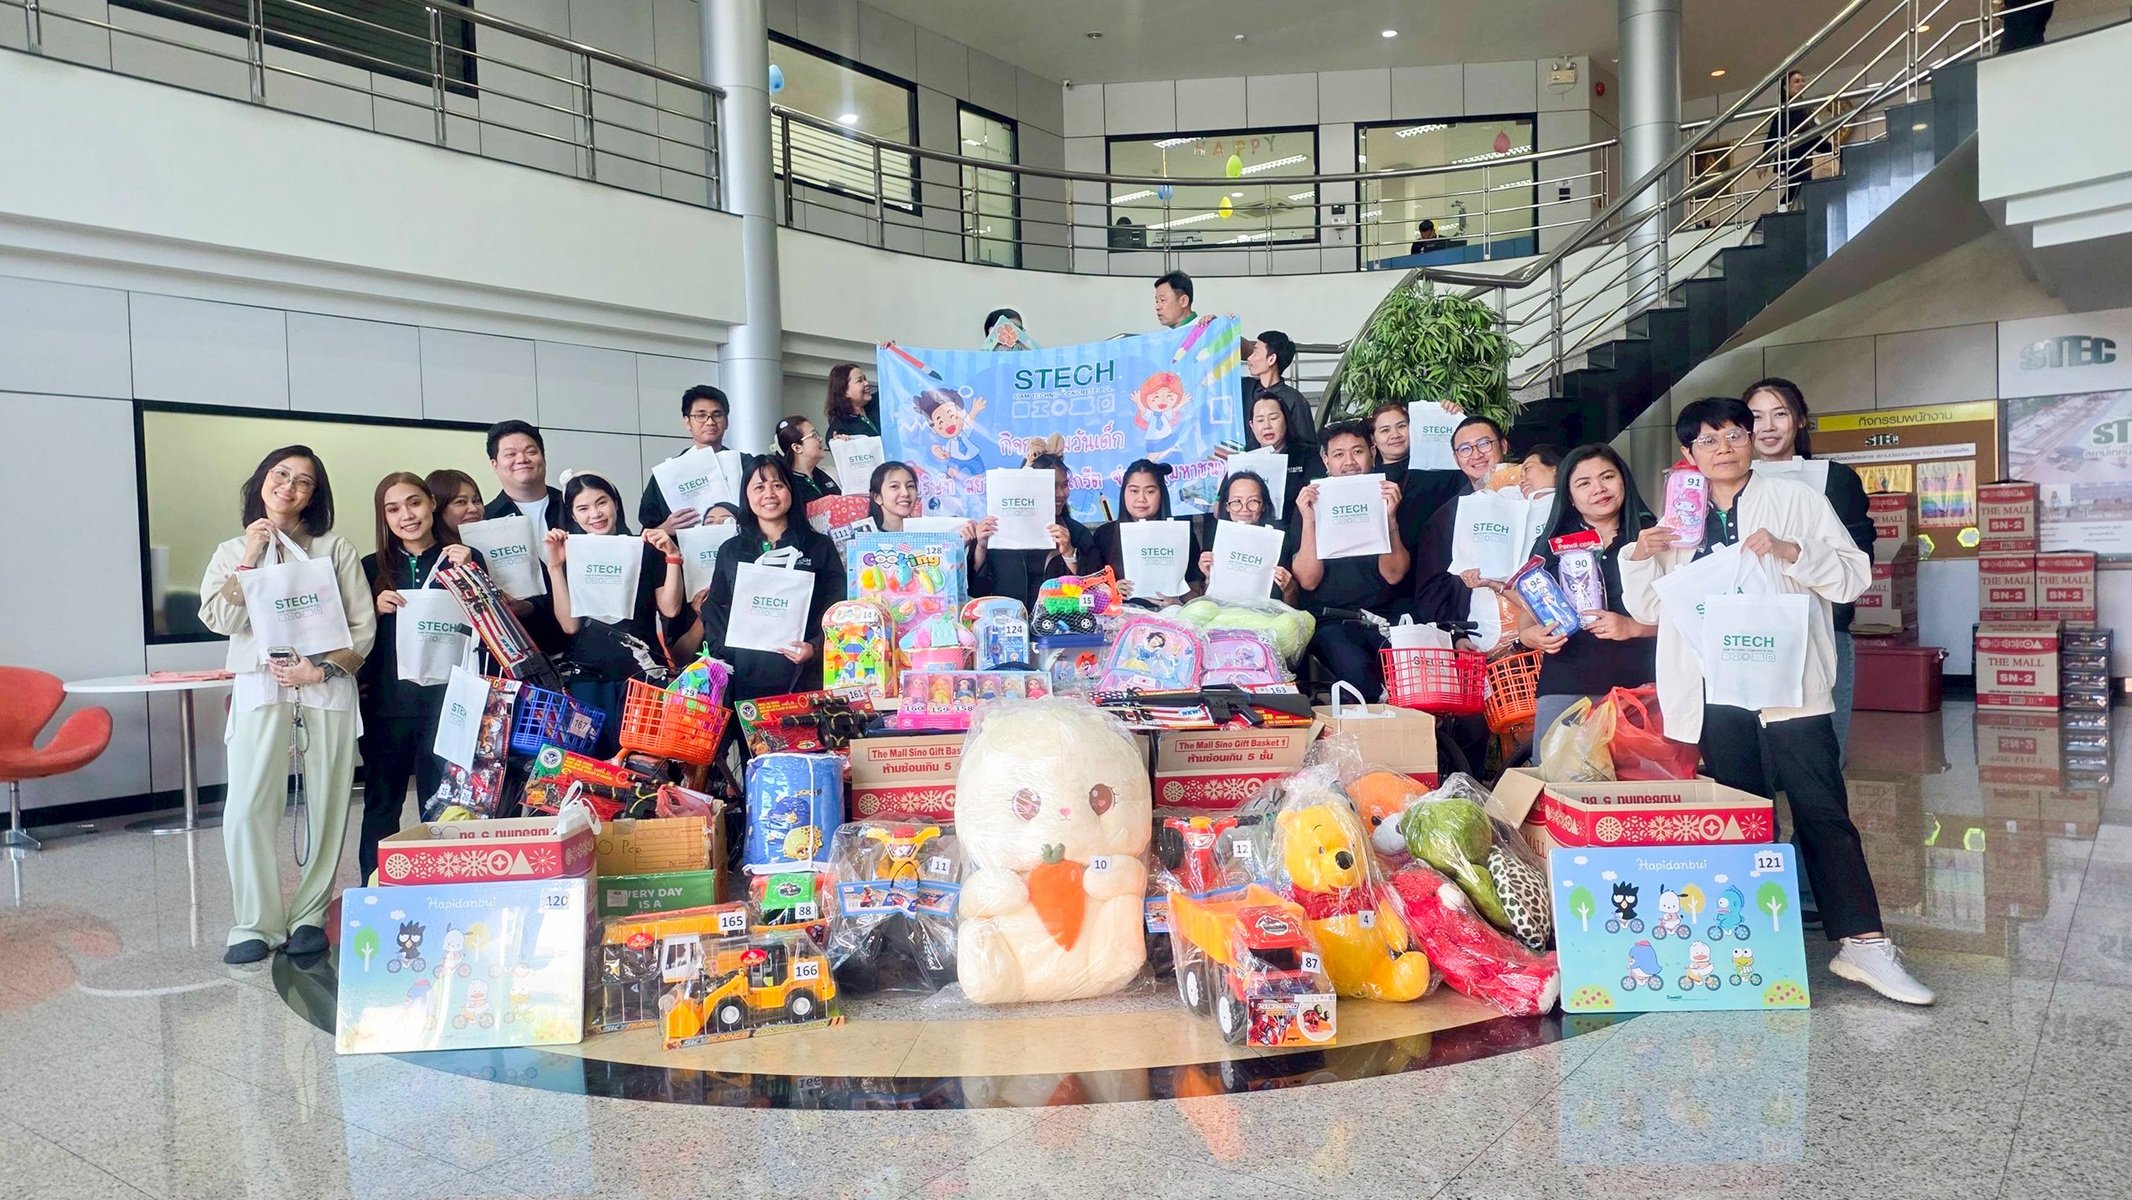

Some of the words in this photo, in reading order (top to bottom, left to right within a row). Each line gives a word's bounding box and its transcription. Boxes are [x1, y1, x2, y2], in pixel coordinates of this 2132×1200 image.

[2020, 335, 2116, 370] STEC
[1014, 359, 1114, 390] STECH
[1858, 411, 1953, 427] กิจกรรมพนักงาน
[1422, 425, 1453, 434] STECH
[848, 454, 875, 463] STECH
[678, 475, 709, 493] STECH
[1687, 477, 1701, 487] 91
[1002, 498, 1035, 507] STECH
[1332, 503, 1368, 515] STECH
[1980, 507, 2000, 515] THE
[2003, 506, 2032, 515] MALL
[1473, 522, 1509, 534] STECH
[1991, 521, 2022, 529] SN-2
[834, 529, 849, 539] 111
[490, 543, 527, 559] STECH
[926, 547, 943, 555] 128
[1141, 547, 1174, 556] STECH
[863, 551, 941, 568] Cooking
[1229, 550, 1263, 566] STECH
[1575, 559, 1588, 568] 90
[586, 564, 622, 574] STECH
[1982, 577, 2001, 585] THE
[2004, 576, 2033, 585] MALL
[2039, 576, 2059, 585] THE
[2062, 576, 2092, 585] MALL
[1082, 596, 1092, 605] 15
[1992, 591, 2023, 600] SN-2
[2049, 591, 2080, 600] SN-2
[275, 593, 318, 610] STECH
[752, 595, 788, 608] STECH
[417, 620, 457, 633] STECH
[1006, 625, 1023, 634] 124
[1723, 635, 1774, 648] STECH
[1988, 657, 2009, 666] THE
[2012, 657, 2044, 667] MALL
[1999, 674, 2033, 683] SN-2
[849, 690, 864, 699] 161
[574, 717, 588, 730] 167
[1179, 742, 1195, 750] The
[1196, 741, 1214, 749] Mall
[1234, 740, 1250, 748] Gift
[1251, 738, 1279, 747] Basket
[871, 749, 888, 759] The
[889, 748, 908, 758] Mall
[909, 748, 927, 757] Sino
[928, 747, 945, 756] Gift
[946, 746, 963, 756] Bas
[1187, 752, 1242, 763] ห้ามซ้อนเกิน
[1247, 752, 1255, 760] 5
[1259, 750, 1274, 760] ชั้น
[882, 761, 940, 774] ห้ามซ้อนเกิน
[944, 762, 952, 771] 5
[1236, 844, 1249, 854] 12
[934, 860, 947, 871] 11
[1095, 859, 1108, 870] 10
[1636, 857, 1707, 872] Hapidanbui
[1758, 857, 1781, 868] 121
[658, 888, 683, 897] DAY
[426, 896, 496, 911] Hapidanbui
[546, 895, 569, 907] 120
[721, 915, 744, 928] 165
[1362, 914, 1370, 924] 4
[1305, 957, 1318, 969] 87
[795, 964, 818, 978] 166
